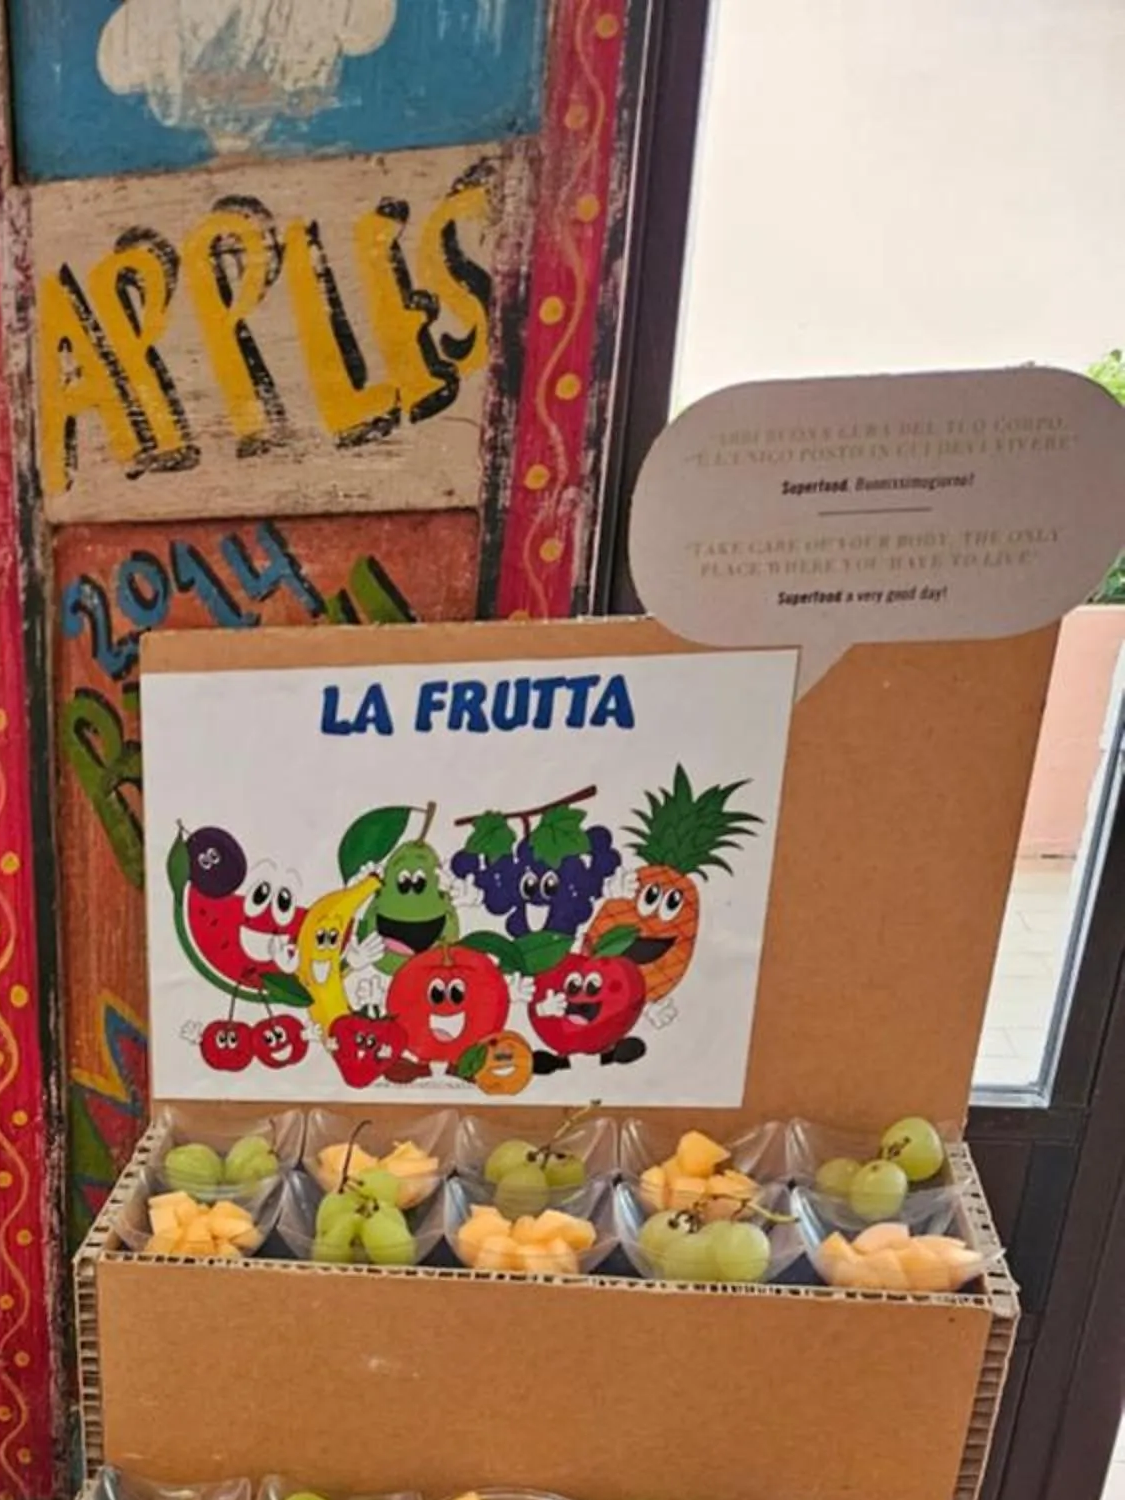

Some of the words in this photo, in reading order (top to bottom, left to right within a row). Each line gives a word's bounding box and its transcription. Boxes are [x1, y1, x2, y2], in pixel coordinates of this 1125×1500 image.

[39, 156, 495, 491] APPLES
[321, 682, 394, 736] LA
[414, 673, 635, 734] FRUTTA
